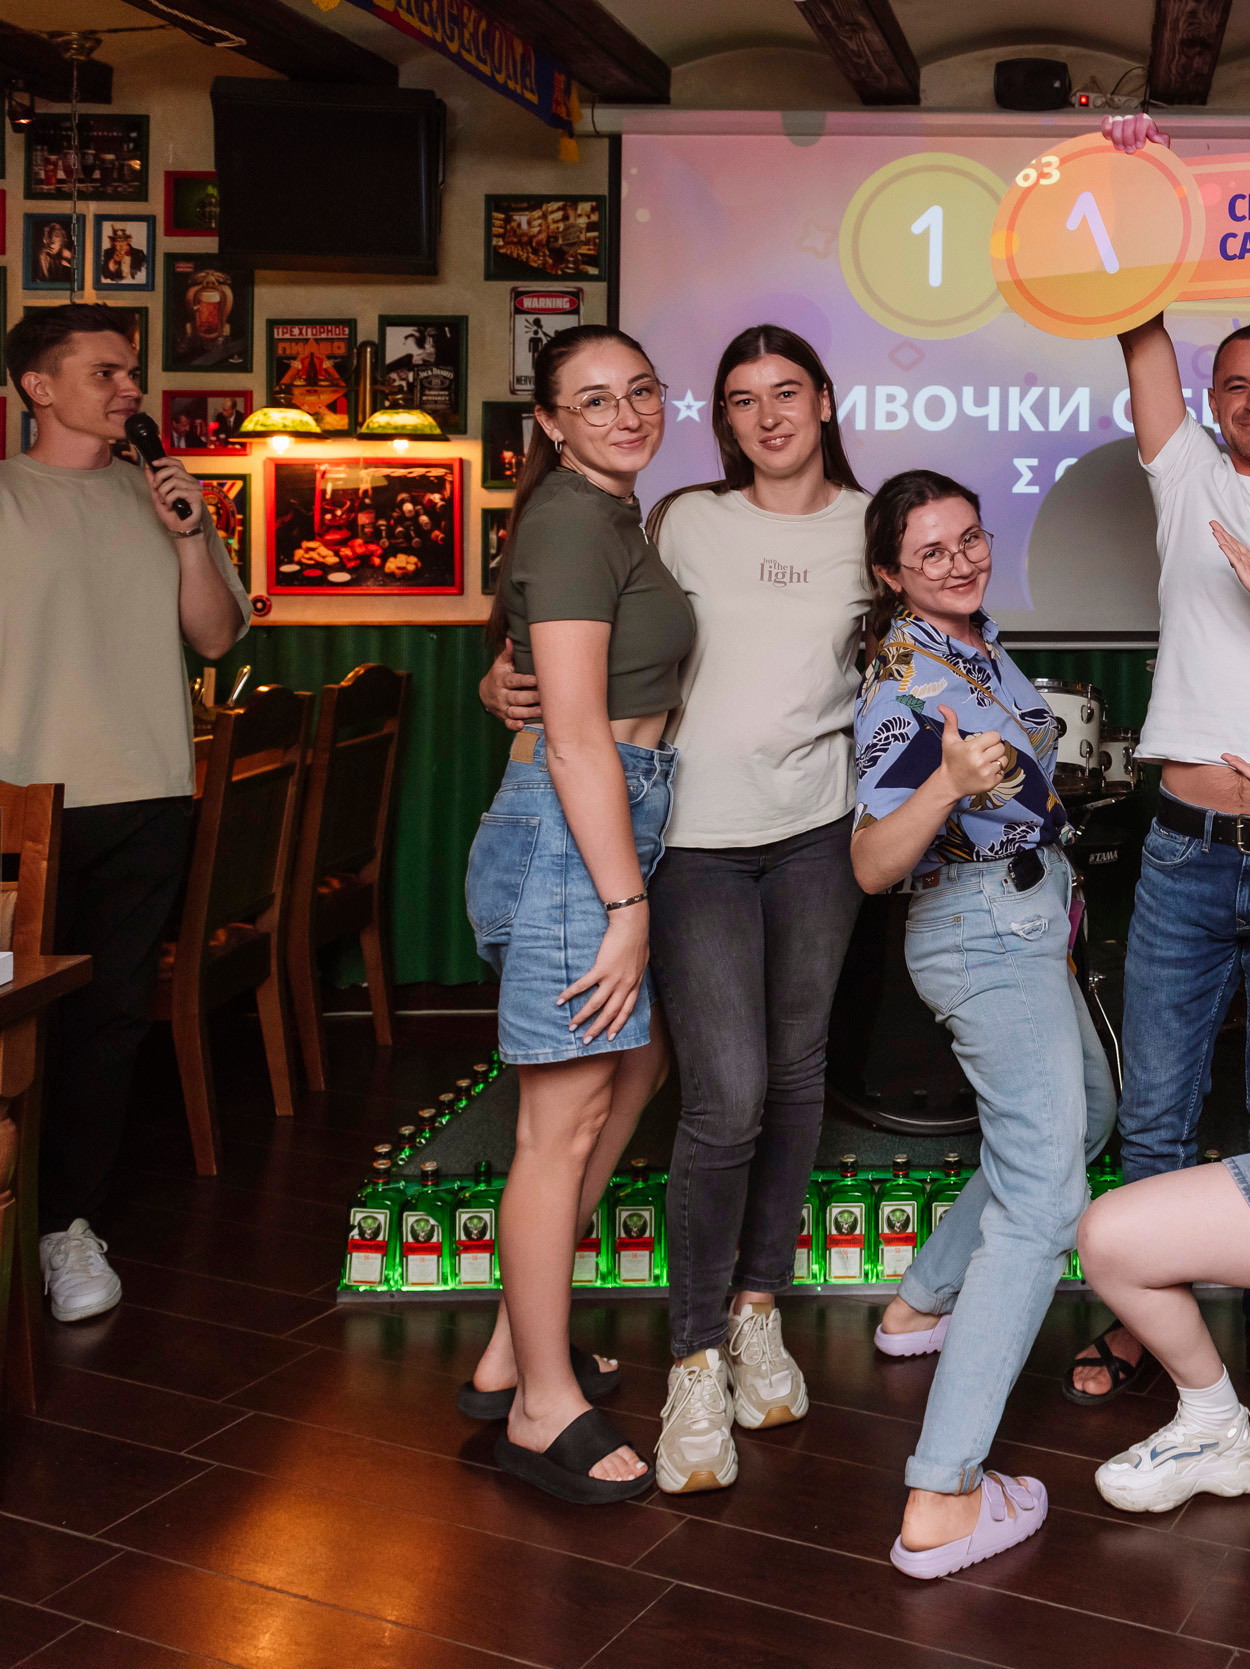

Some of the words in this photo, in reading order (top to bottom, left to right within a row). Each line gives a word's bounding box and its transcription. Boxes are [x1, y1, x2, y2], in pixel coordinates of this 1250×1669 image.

[911, 205, 943, 287] 1
[1066, 191, 1119, 274] 1
[523, 297, 570, 309] WARNING
[275, 326, 348, 337] ТРЕХГОРНОЕ
[833, 384, 1091, 432] ИВОЧКИ
[759, 563, 811, 588] light
